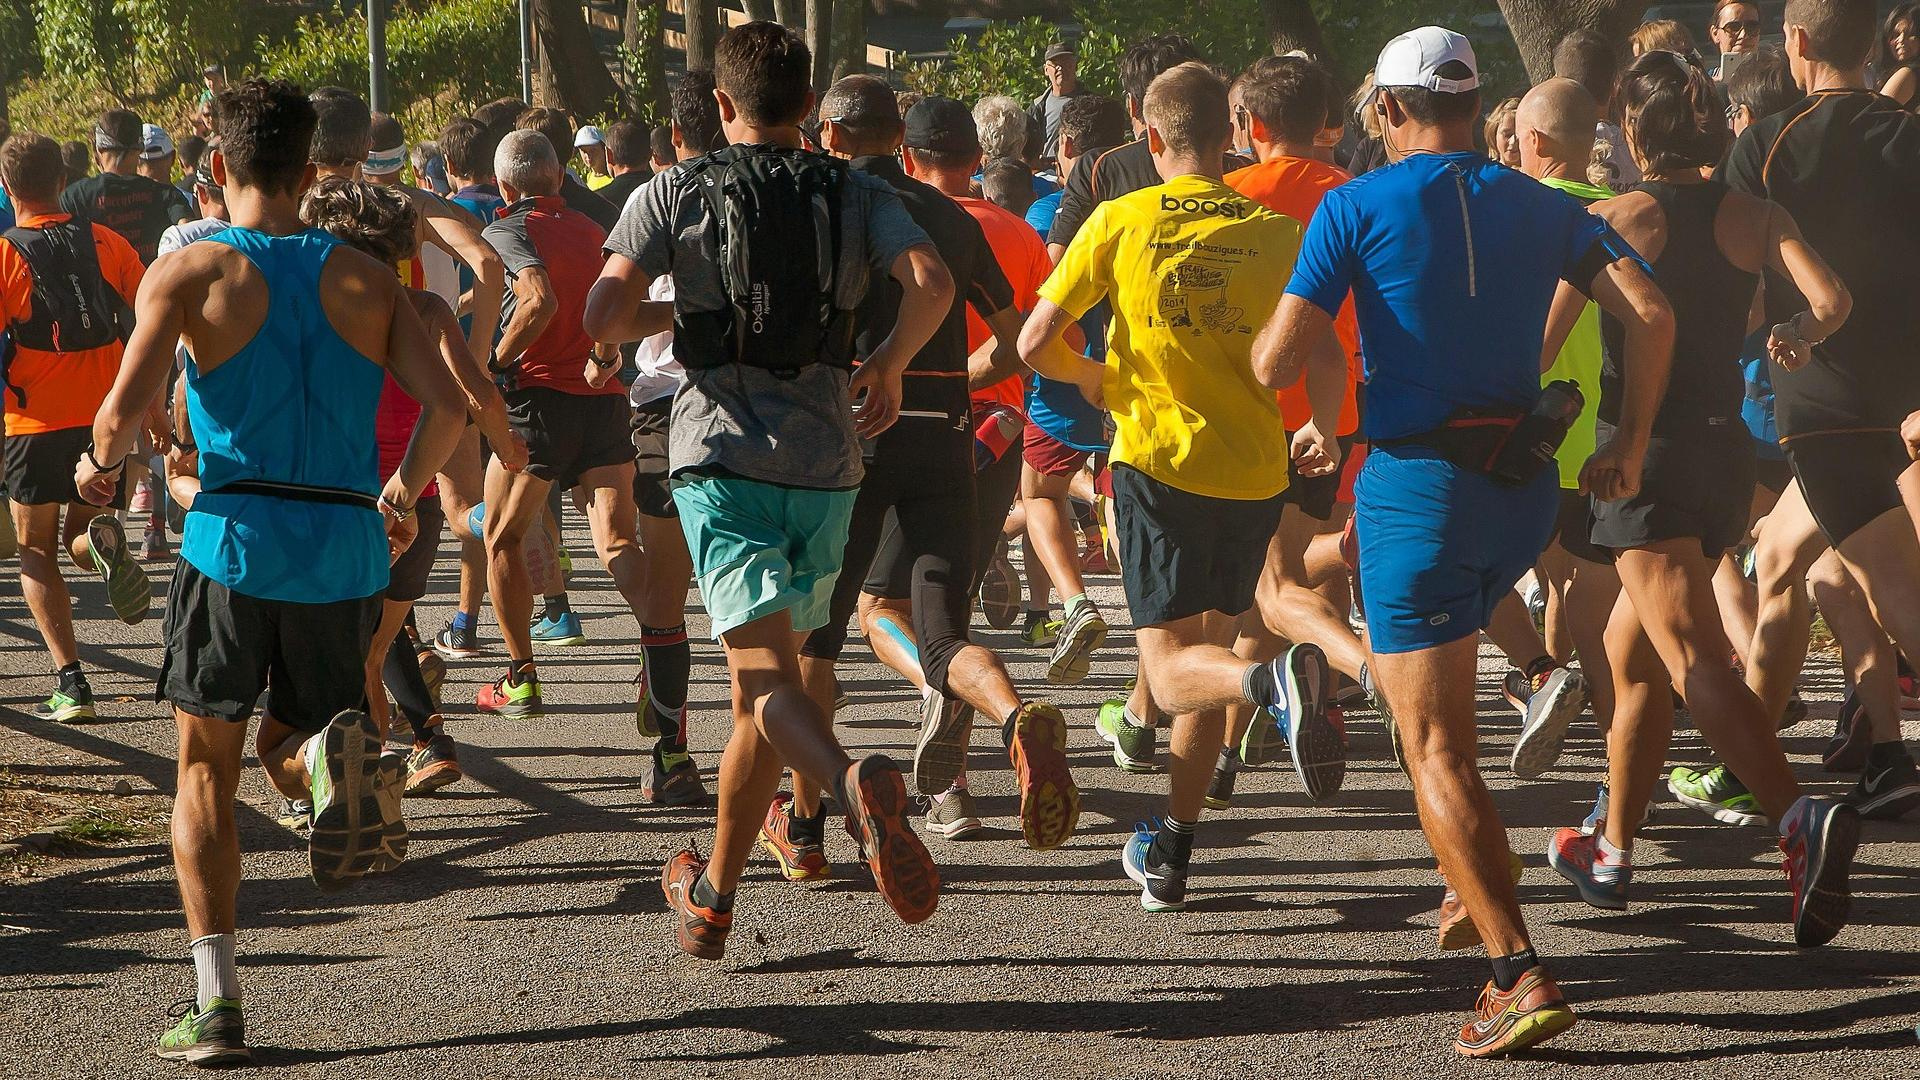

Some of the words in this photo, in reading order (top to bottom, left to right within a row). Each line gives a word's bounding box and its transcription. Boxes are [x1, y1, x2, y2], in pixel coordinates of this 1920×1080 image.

[1161, 194, 1246, 219] boost
[1149, 241, 1259, 257] www.trailbouzigues.fr
[752, 283, 763, 334] Oxsitis
[1163, 297, 1185, 308] 2014
